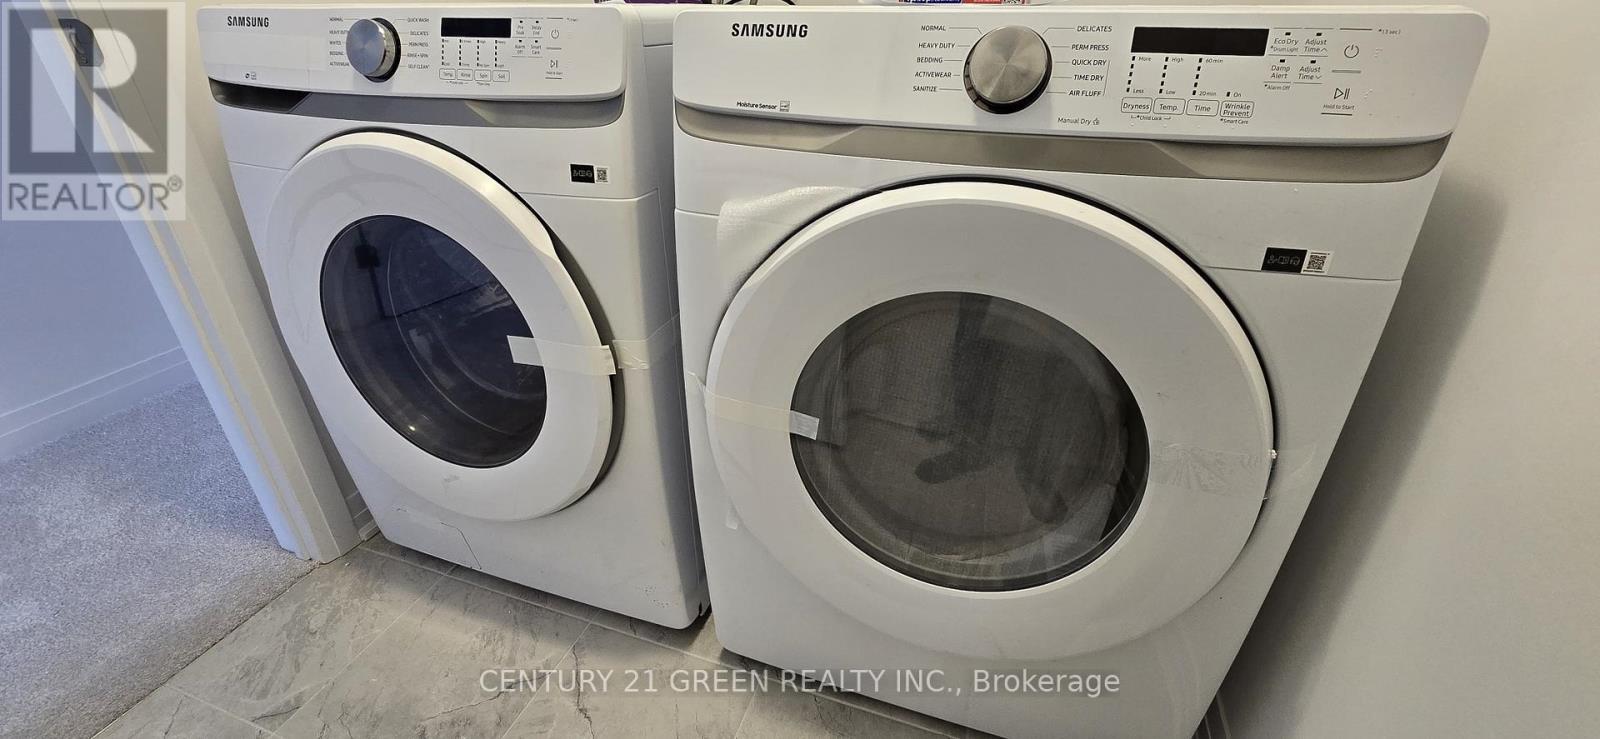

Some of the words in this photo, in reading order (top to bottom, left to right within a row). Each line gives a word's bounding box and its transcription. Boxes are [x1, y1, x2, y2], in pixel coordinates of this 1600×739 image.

[227, 15, 270, 28] SAMSUNG
[731, 23, 809, 39] SAMSUNG
[1077, 25, 1113, 33] DELICATES
[1286, 38, 1299, 46] Dry
[1305, 38, 1327, 46] Adjust
[1090, 44, 1110, 52] PRESS
[1071, 59, 1092, 67] QUICK
[1093, 59, 1107, 67] DRY
[1271, 65, 1290, 73] Damp
[1300, 66, 1321, 74] Adjust
[1090, 74, 1105, 82] DRY
[736, 101, 758, 109] Moisture
